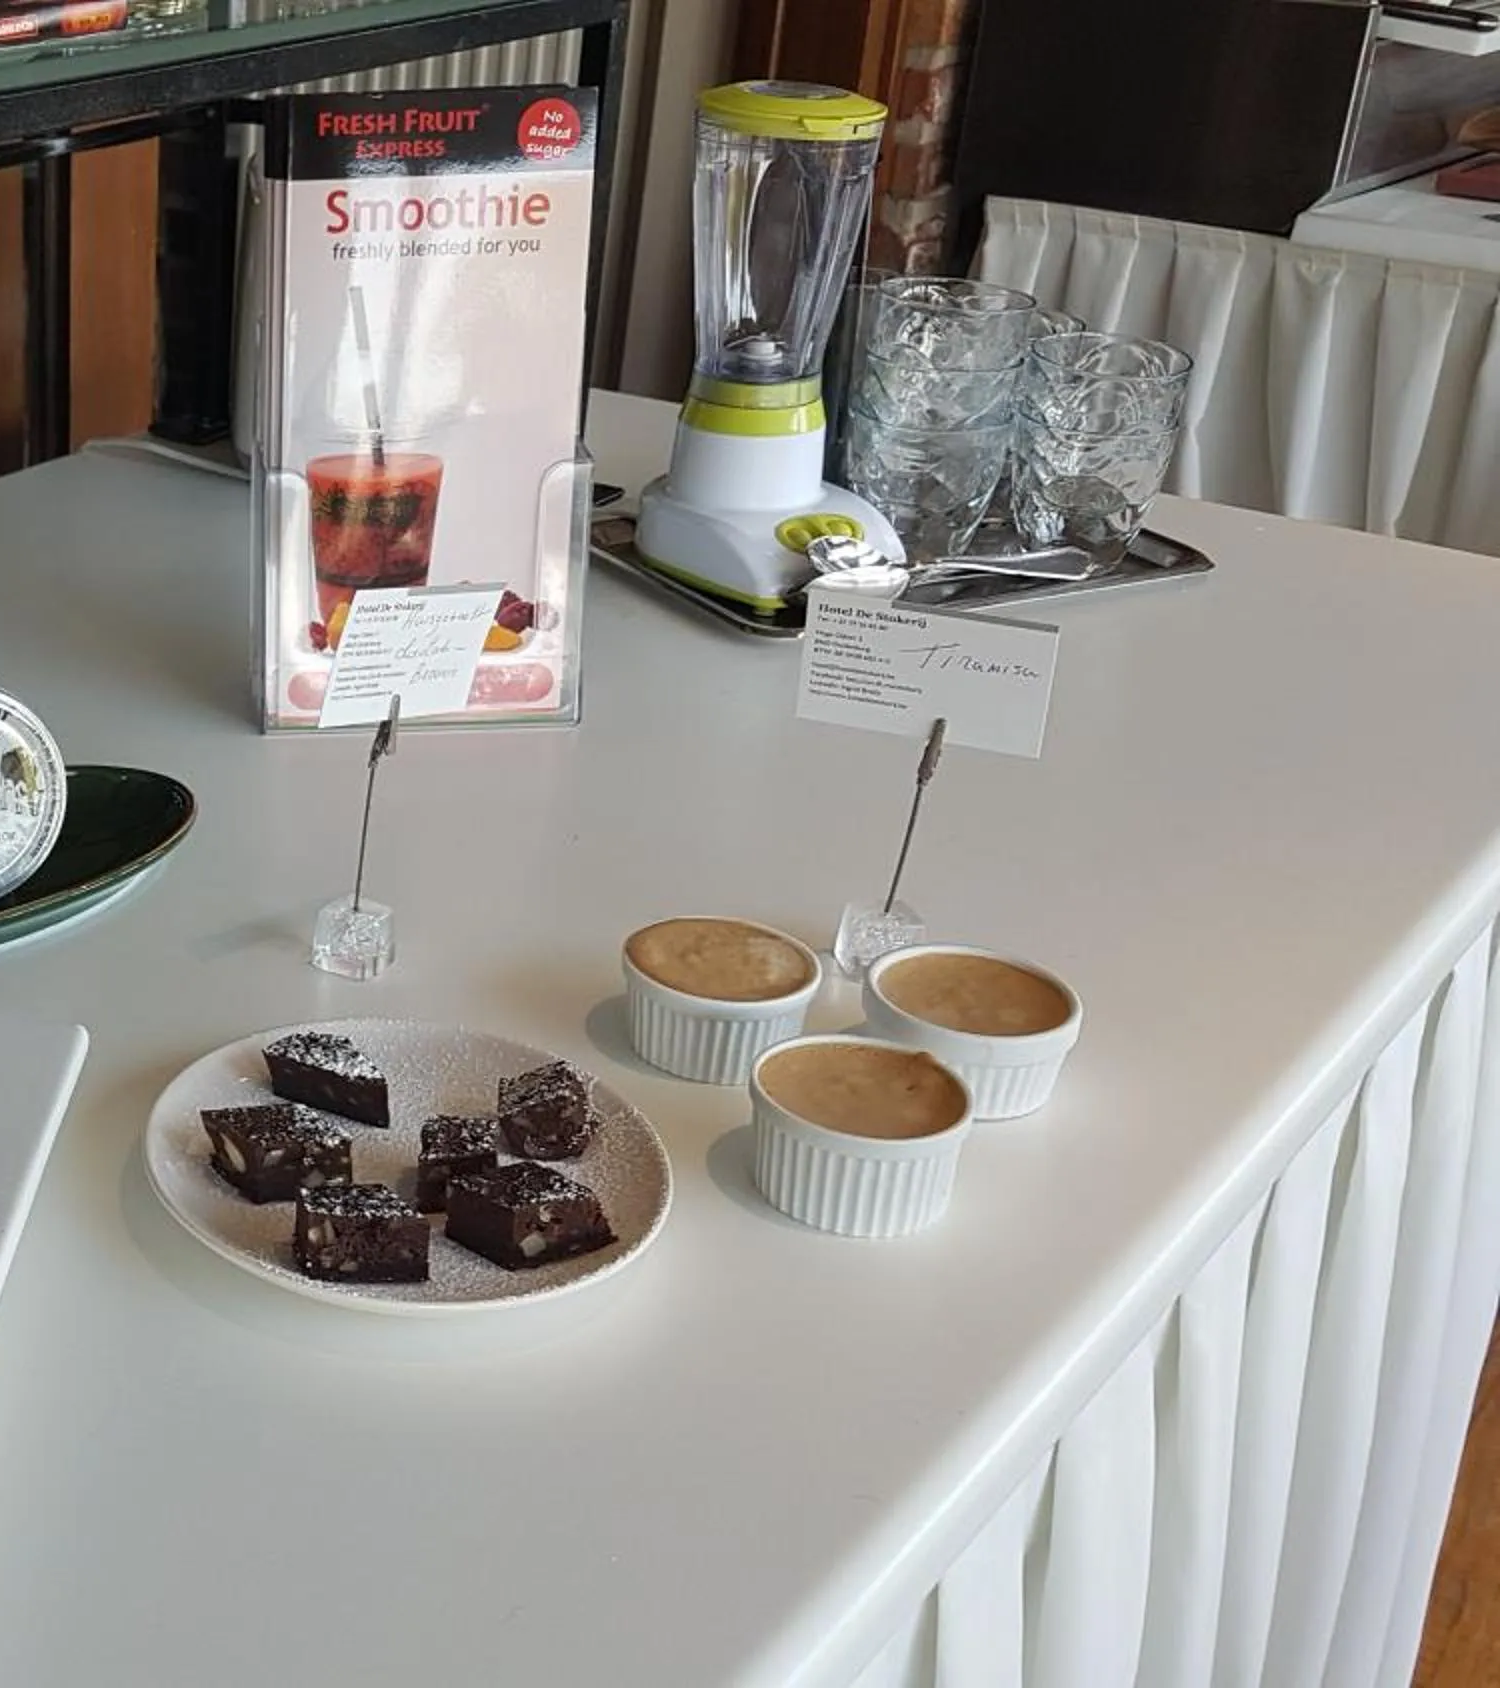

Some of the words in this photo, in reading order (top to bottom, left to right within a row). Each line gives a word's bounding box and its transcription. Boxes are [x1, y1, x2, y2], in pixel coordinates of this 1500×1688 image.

[318, 109, 397, 136] FRESH
[403, 106, 481, 133] FRUIT
[543, 110, 564, 123] No
[528, 125, 572, 140] added
[355, 138, 446, 159] EXPRESS
[525, 143, 574, 160] sugar
[326, 183, 550, 234] Smoothie
[333, 239, 397, 262] freshly
[399, 237, 472, 257] blended
[476, 236, 502, 255] for
[507, 238, 541, 257] you
[819, 603, 853, 617] Hotel
